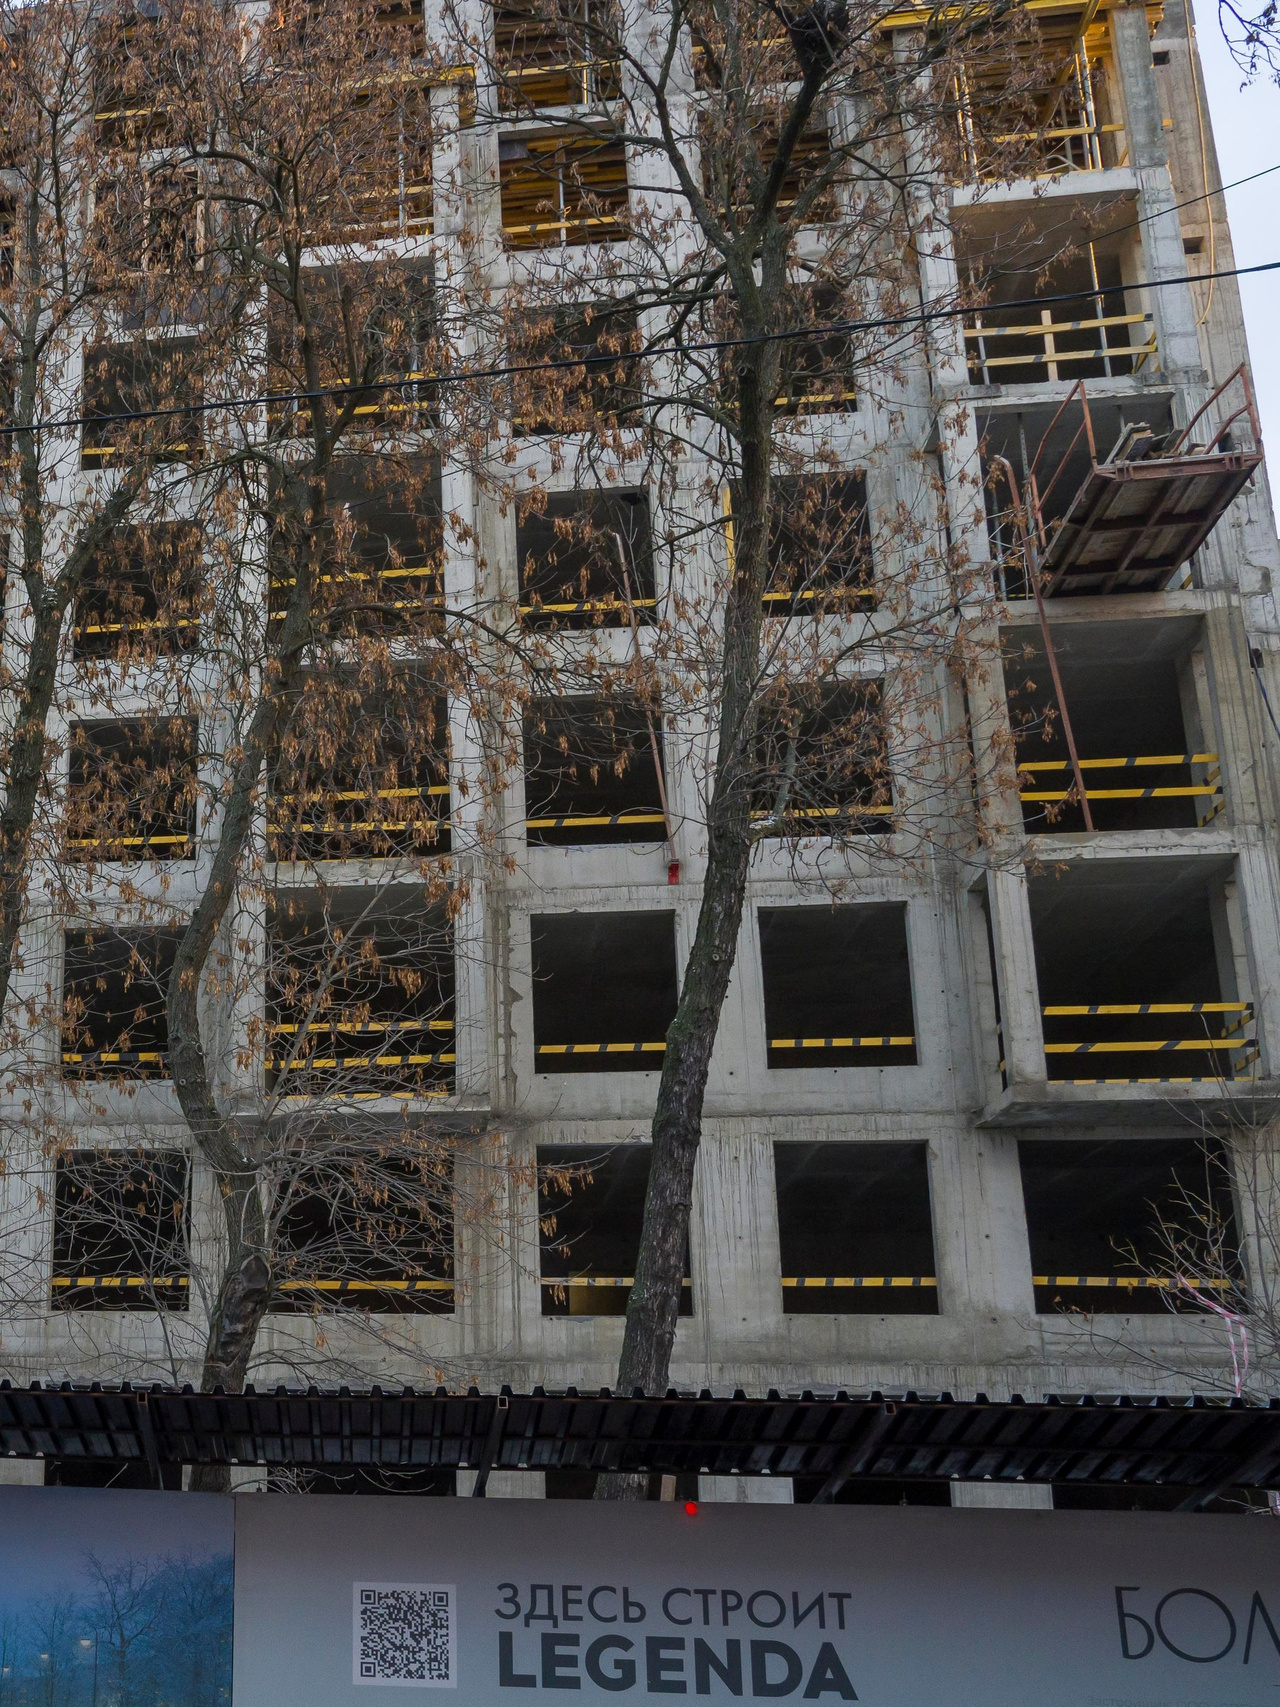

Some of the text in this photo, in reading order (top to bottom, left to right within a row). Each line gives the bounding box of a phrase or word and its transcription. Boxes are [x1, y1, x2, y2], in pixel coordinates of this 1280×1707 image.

[494, 1582, 853, 1631] ЗДЕСЬ СТРОИТ
[1115, 1586, 1280, 1665] БОЛ
[498, 1630, 860, 1701] LEGENDA
